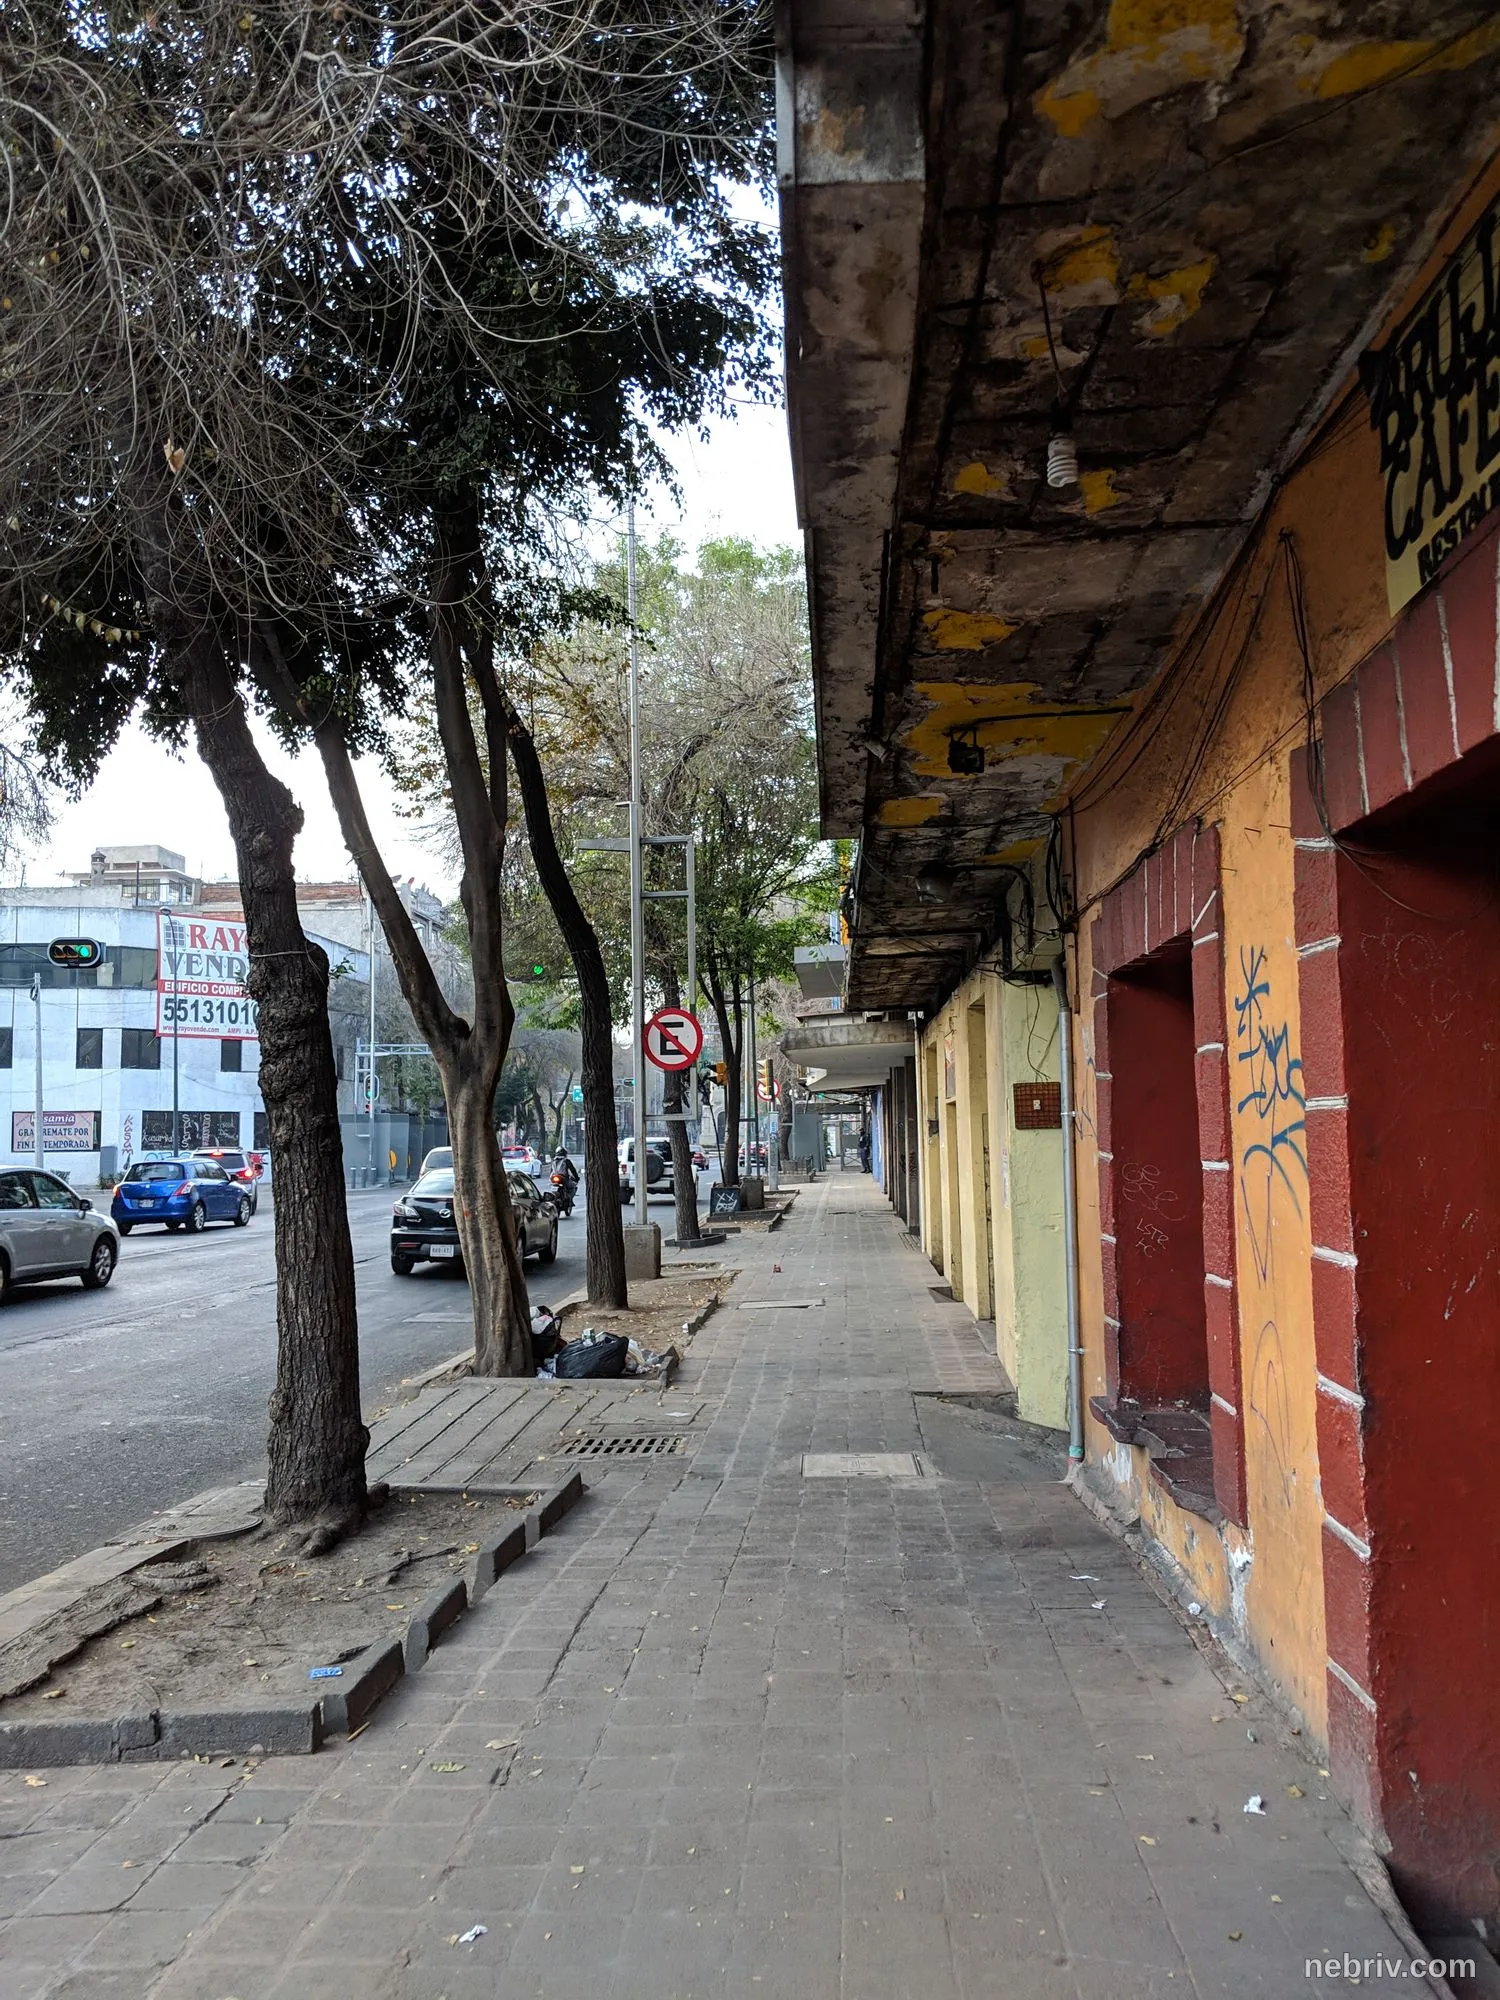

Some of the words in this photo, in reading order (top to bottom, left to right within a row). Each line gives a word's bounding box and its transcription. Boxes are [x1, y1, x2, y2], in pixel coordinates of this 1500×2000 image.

[1379, 210, 1500, 472] BRUJ
[165, 952, 247, 979] VEND
[163, 1025, 220, 1033] wwwrayovende.com
[660, 1021, 685, 1055] E
[74, 1127, 89, 1136] POR
[44, 1139, 90, 1149] TEMPORADA
